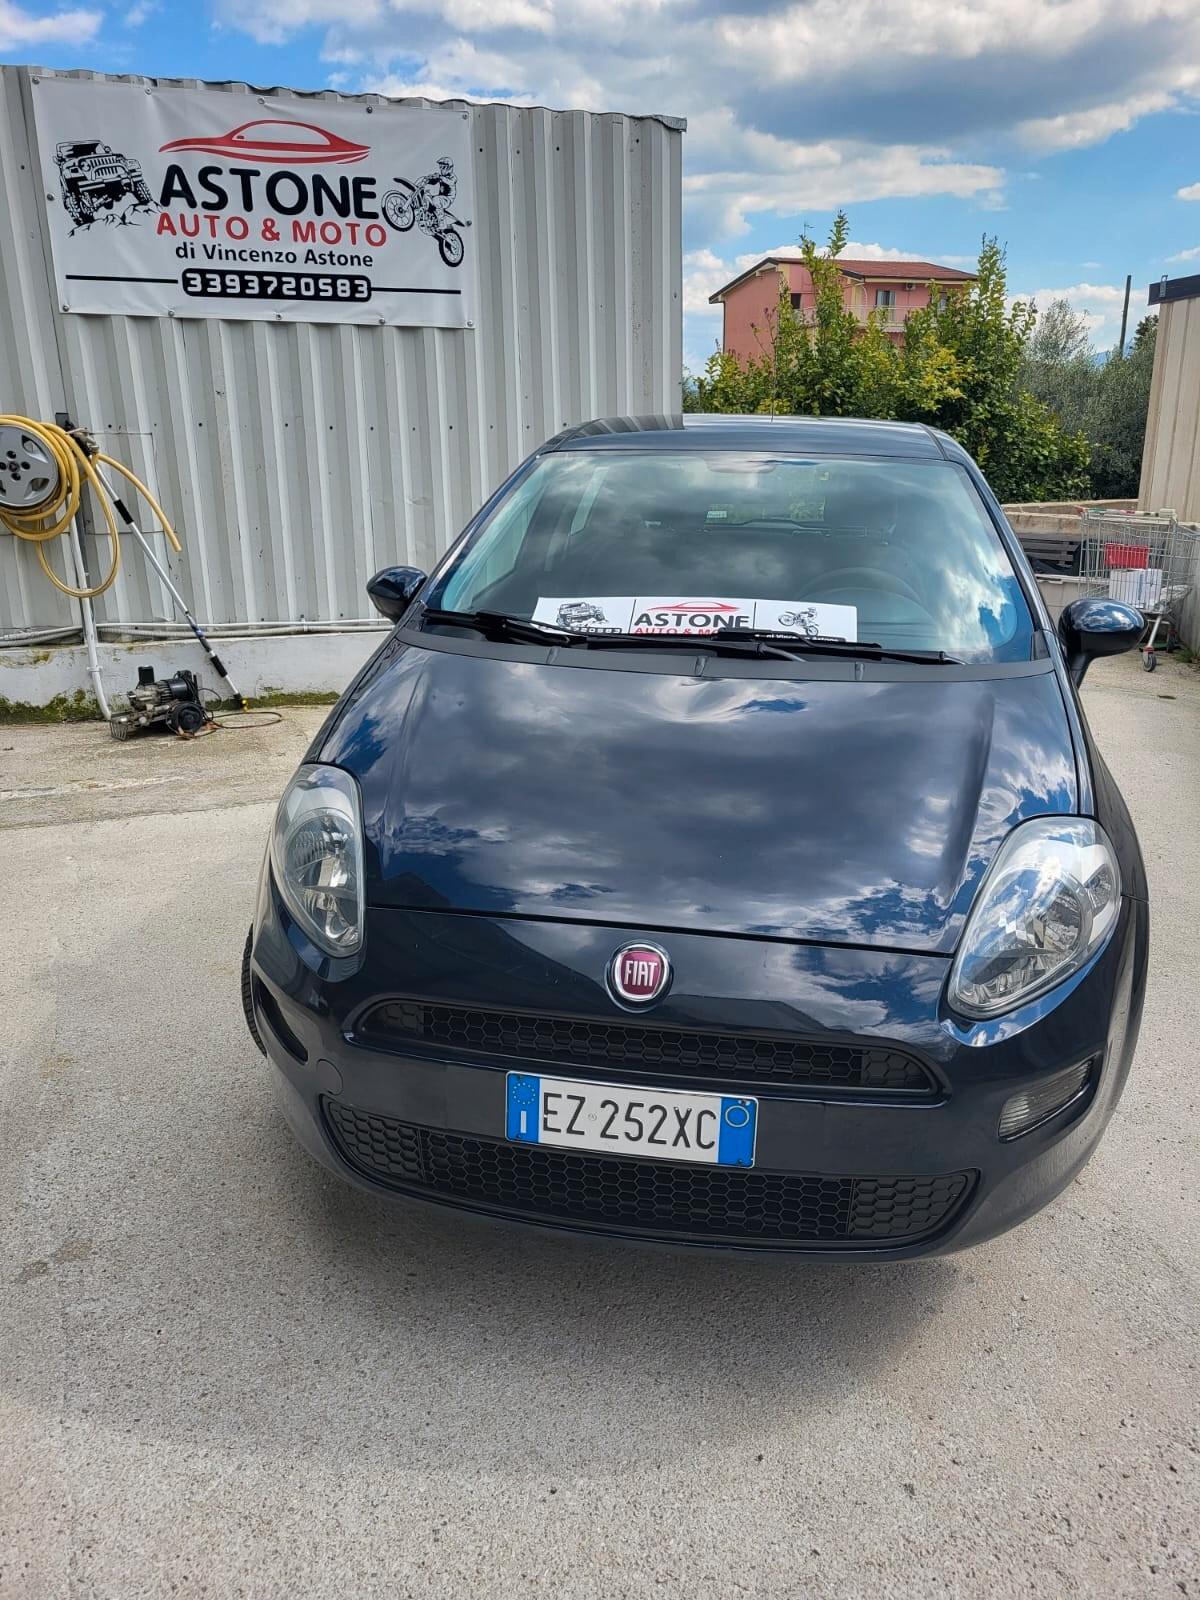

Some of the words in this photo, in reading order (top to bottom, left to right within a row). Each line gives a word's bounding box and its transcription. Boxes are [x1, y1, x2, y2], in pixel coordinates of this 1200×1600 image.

[159, 164, 379, 220] ASTONE
[156, 212, 249, 241] AUTO
[261, 217, 280, 241] &
[292, 220, 387, 247] MOTO
[175, 241, 196, 260] di
[202, 243, 297, 264] Vincenzo
[304, 248, 373, 267] Astone
[185, 272, 369, 298] 3393720583
[624, 960, 657, 987] FIAT
